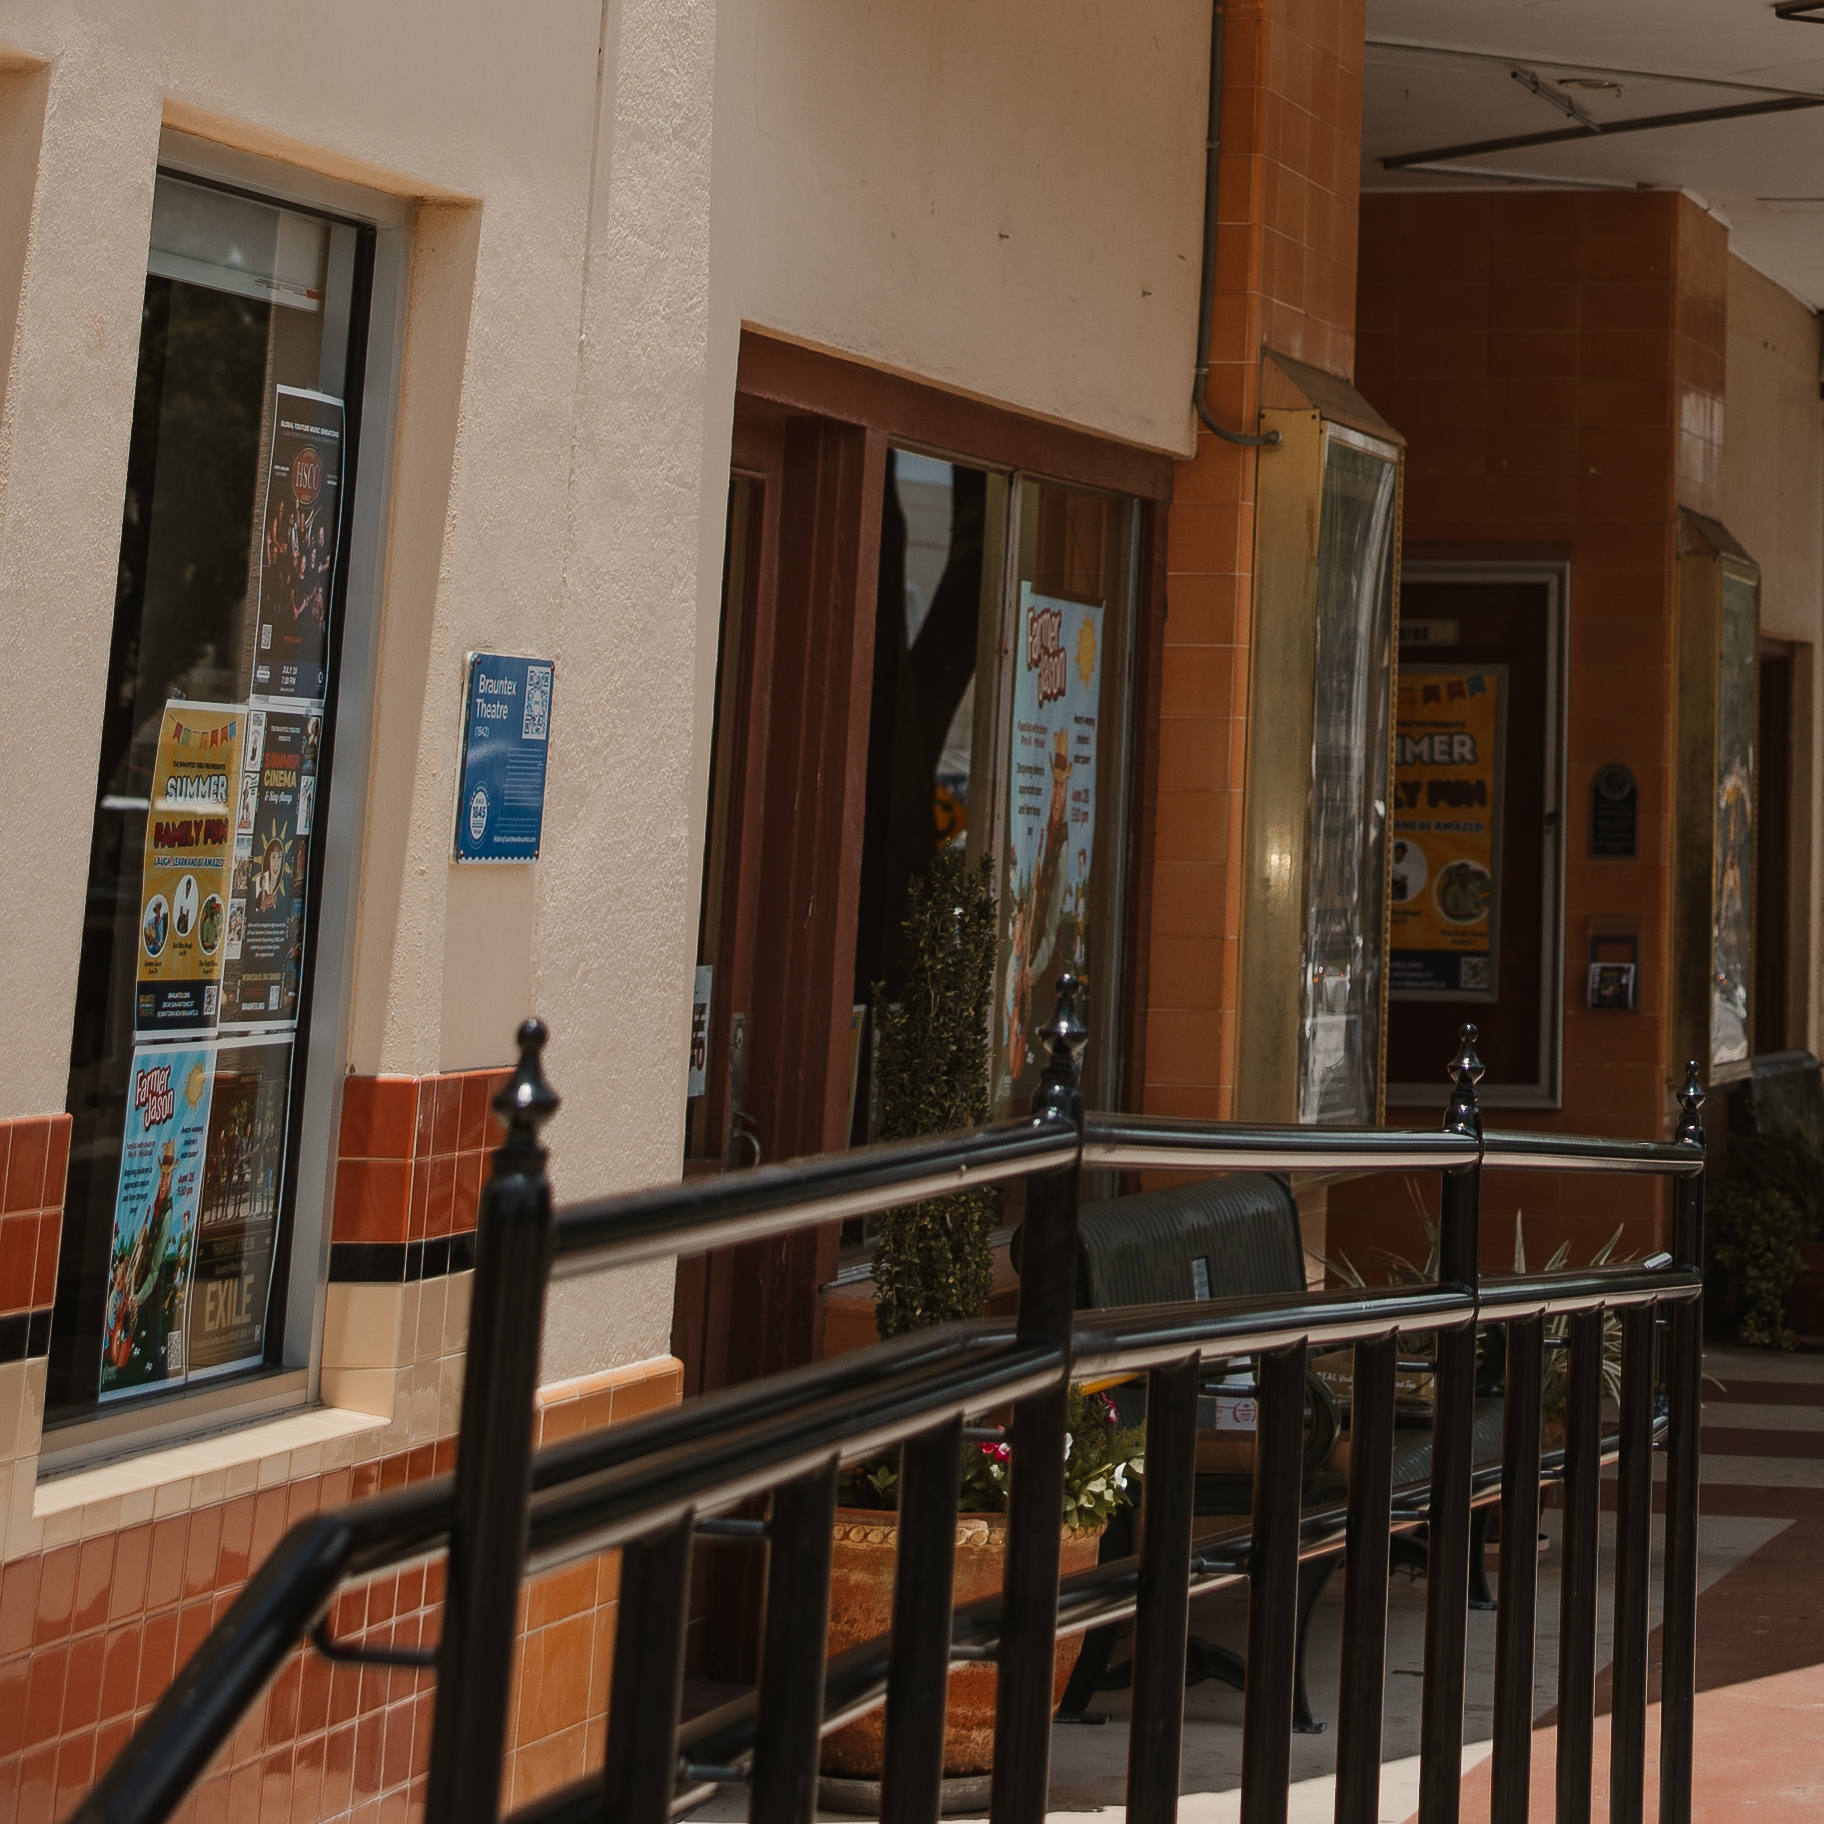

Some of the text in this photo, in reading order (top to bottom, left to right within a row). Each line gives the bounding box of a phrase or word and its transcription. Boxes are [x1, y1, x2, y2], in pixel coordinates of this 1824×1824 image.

[296, 461, 320, 490] HSCC
[1027, 606, 1062, 671] Farmer
[478, 674, 517, 695] Brauntex
[476, 698, 508, 720] Theatre
[166, 774, 228, 806] SUMMER
[264, 770, 297, 787] CINEMA
[473, 806, 486, 819] 1845
[154, 818, 228, 849] FAMILY FUN
[135, 1065, 171, 1111] Farmer
[144, 1088, 175, 1132] Jason
[205, 1274, 254, 1331] EXILE
